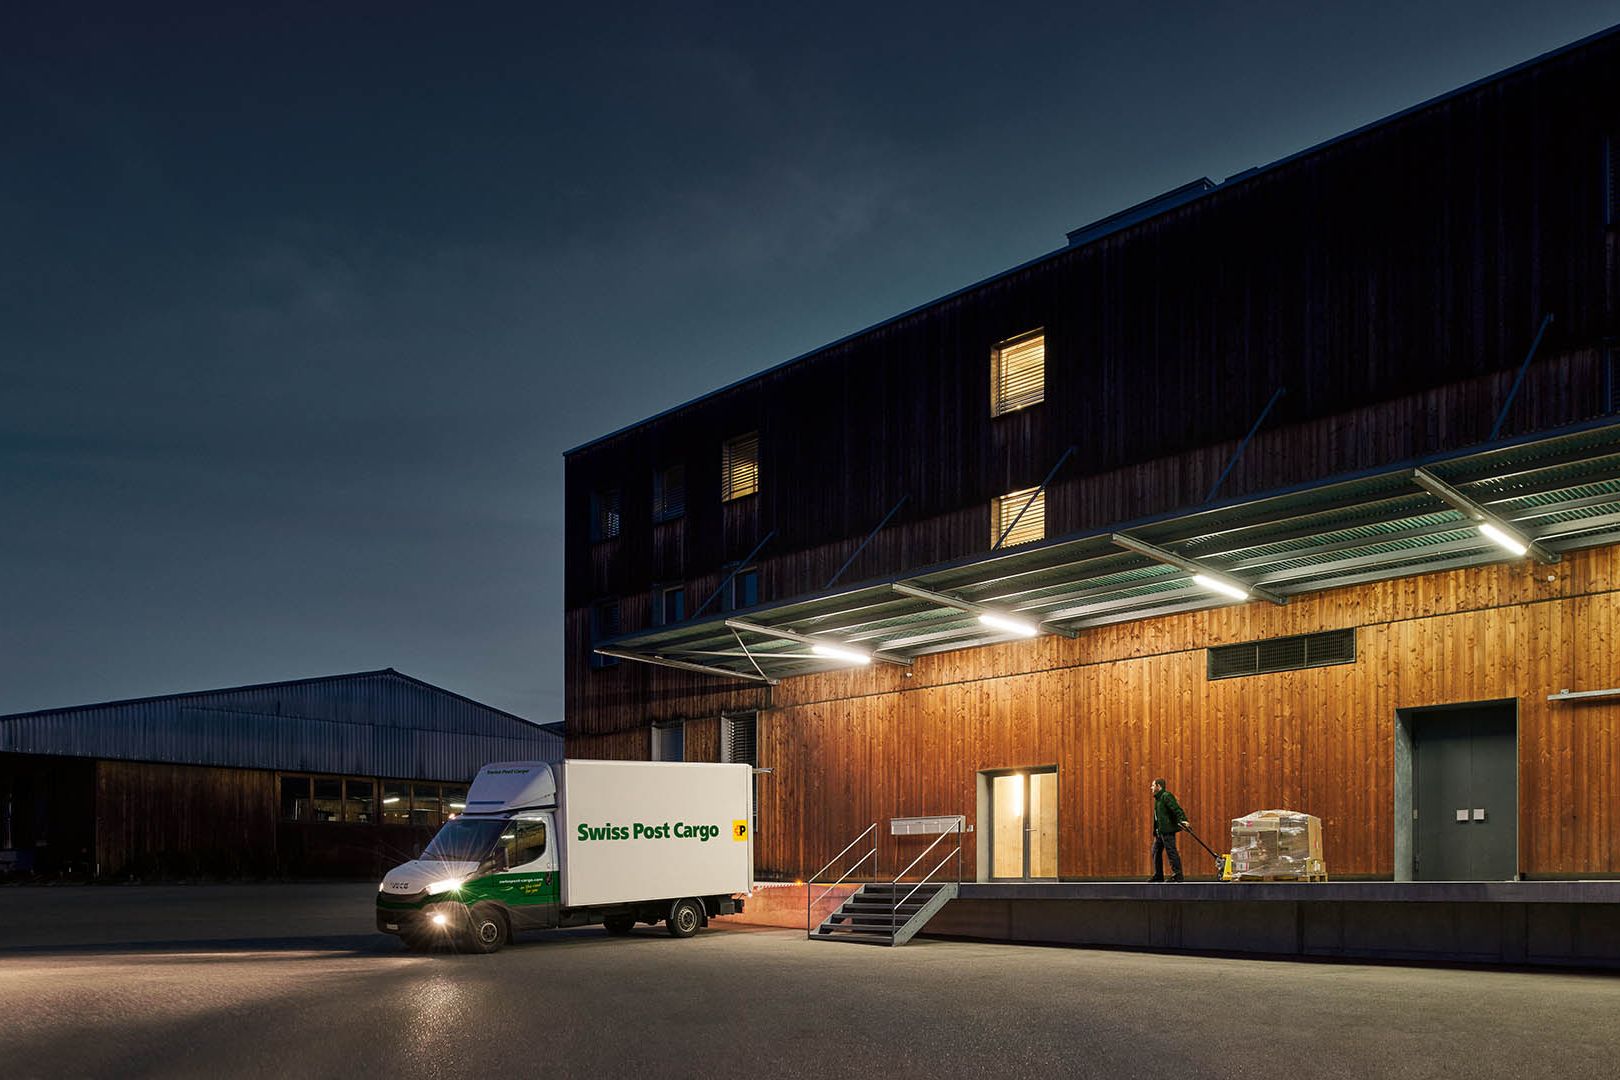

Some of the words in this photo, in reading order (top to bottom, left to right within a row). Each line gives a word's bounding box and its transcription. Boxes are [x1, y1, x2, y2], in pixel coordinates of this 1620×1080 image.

[577, 822, 629, 841] Swiss
[633, 822, 670, 839] Post
[673, 822, 720, 842] Cargo
[739, 825, 746, 836] P
